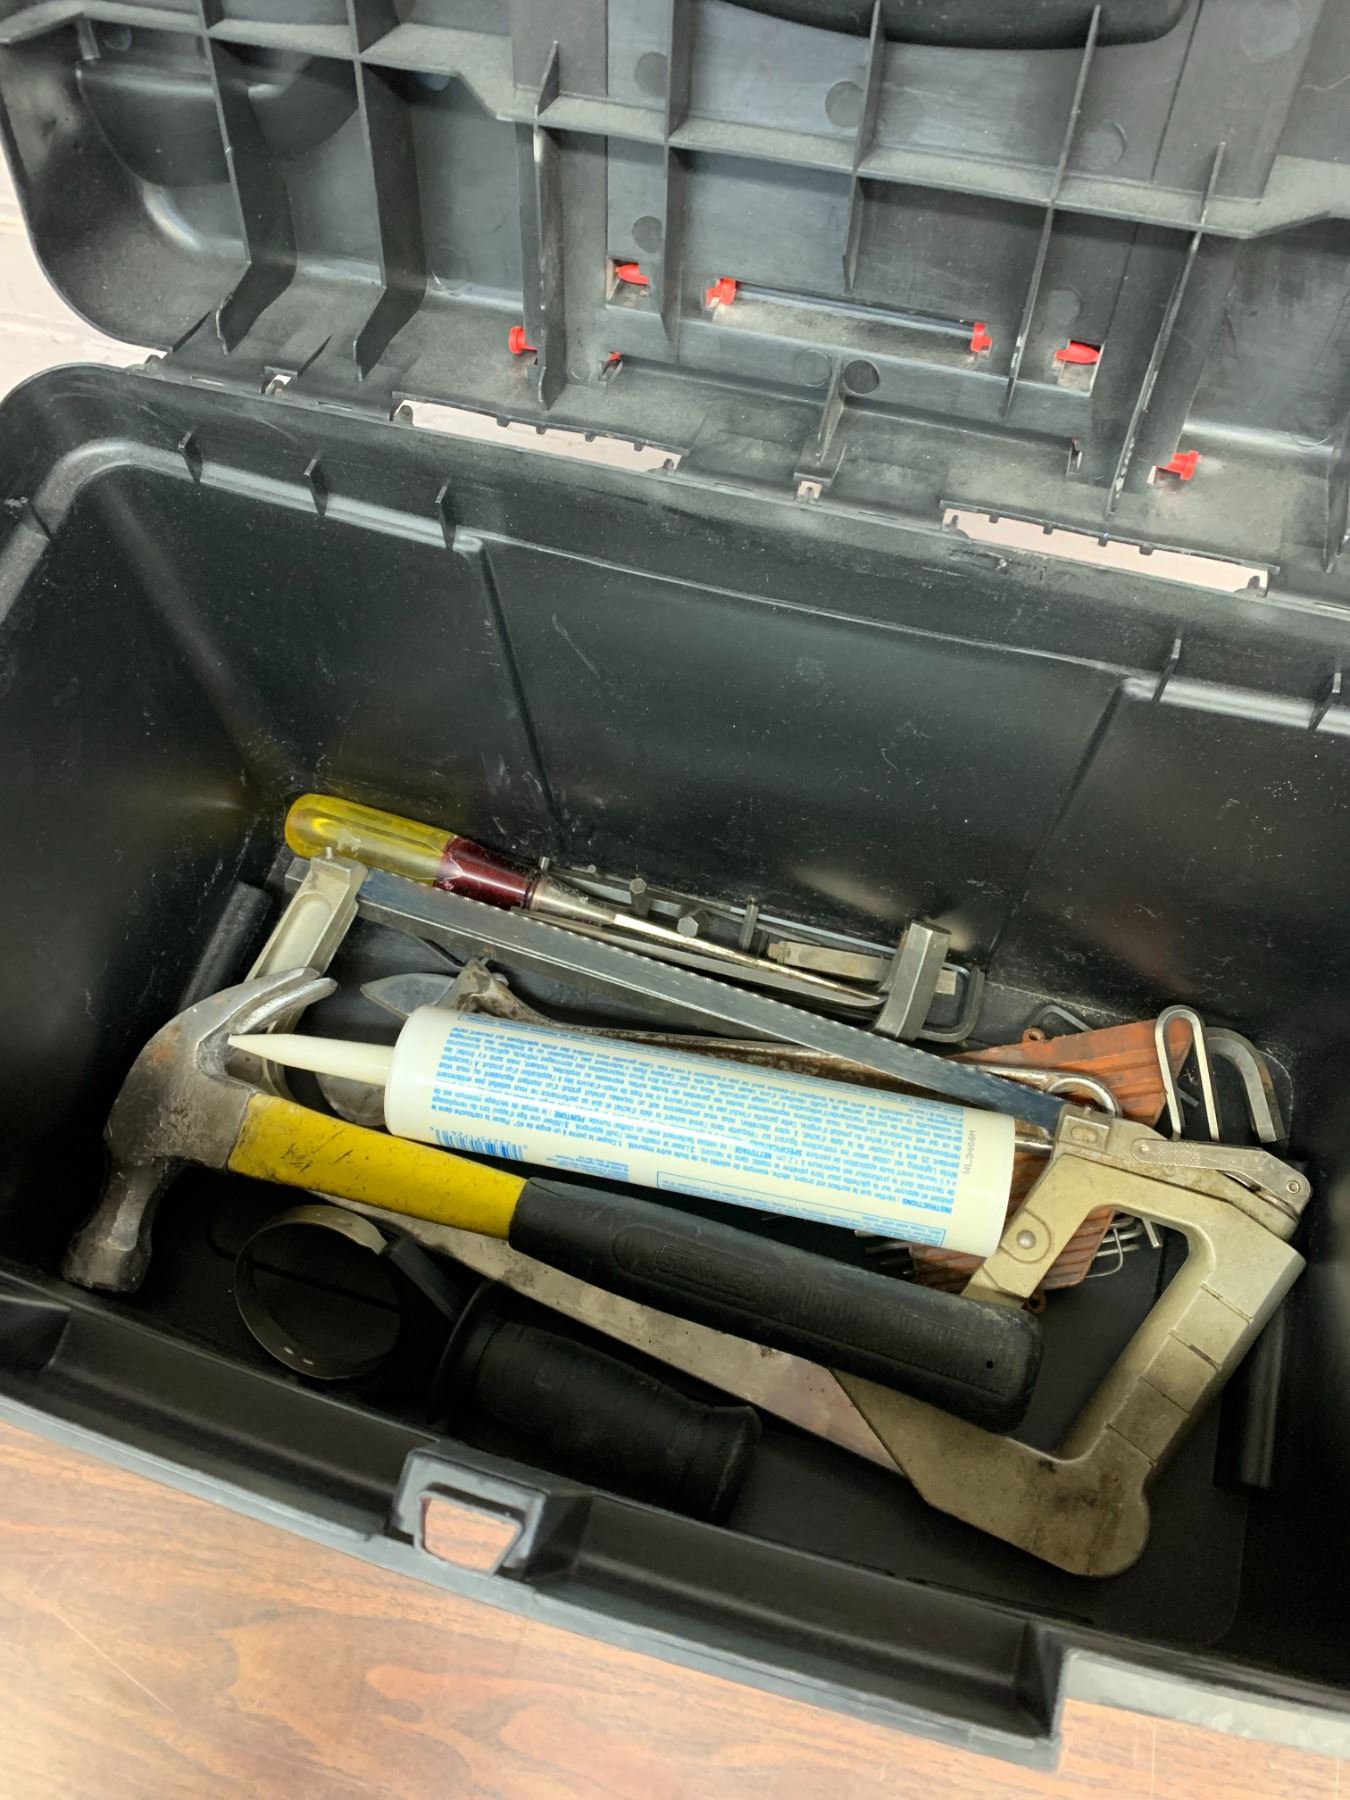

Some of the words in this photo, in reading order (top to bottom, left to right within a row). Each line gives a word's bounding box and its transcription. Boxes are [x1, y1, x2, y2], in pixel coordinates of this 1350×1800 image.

[553, 1111, 585, 1122] PEINTURE
[734, 1146, 772, 1159] NETTOYAGE
[901, 1198, 952, 1213] INSTRUCTIONS
